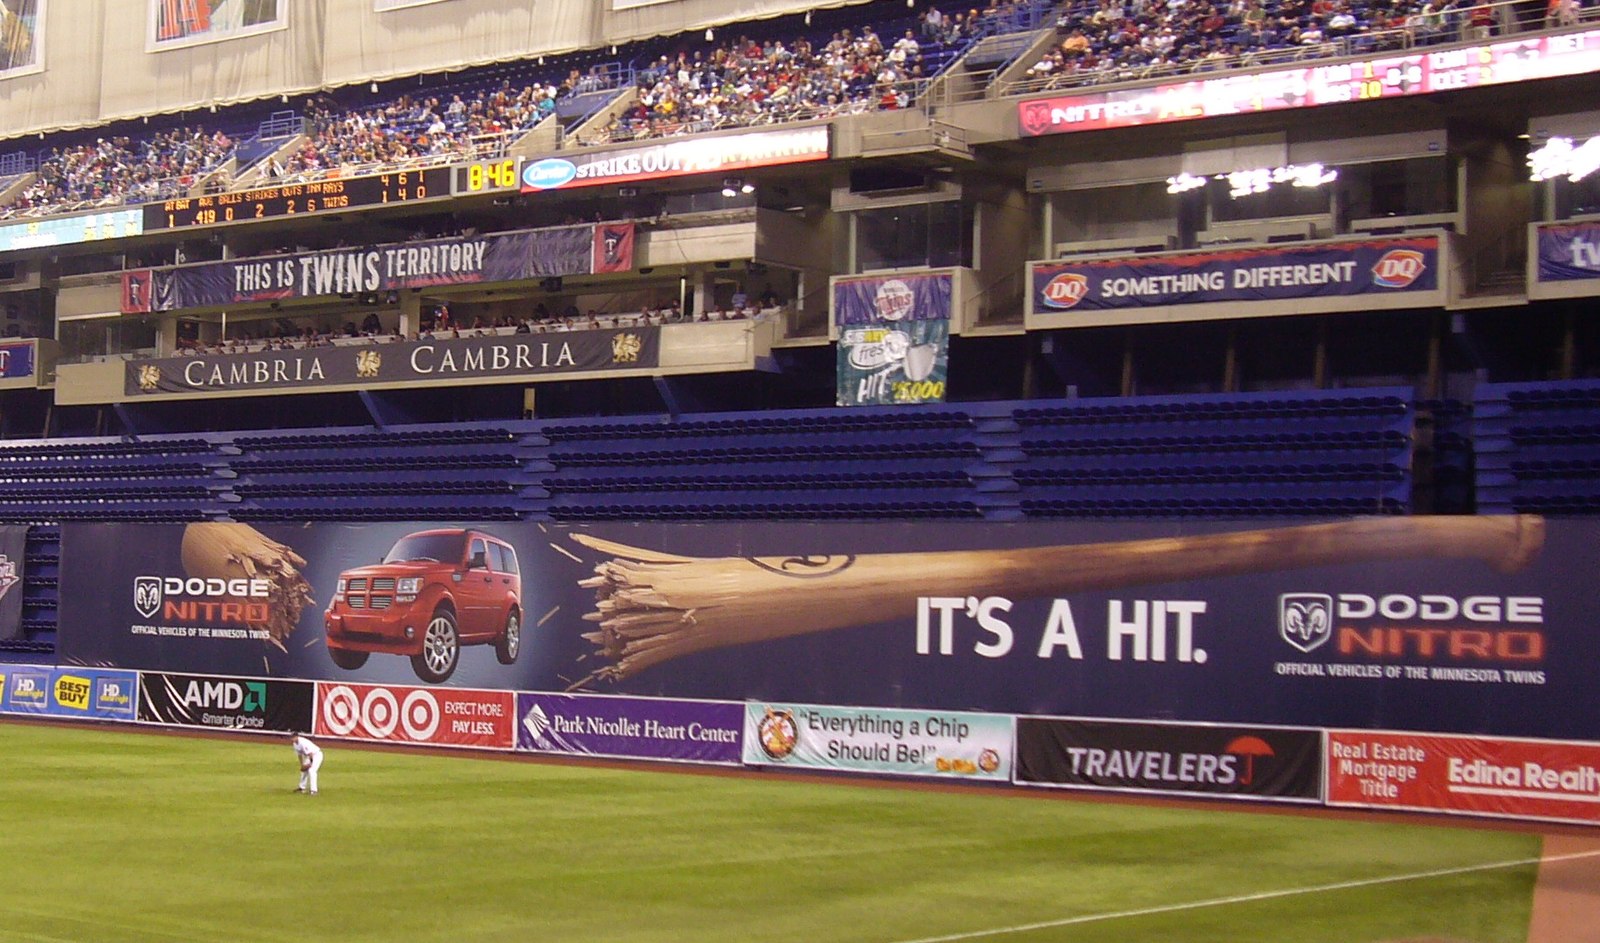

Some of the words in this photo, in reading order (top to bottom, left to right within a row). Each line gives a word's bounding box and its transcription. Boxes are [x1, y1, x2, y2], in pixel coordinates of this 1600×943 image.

[470, 160, 515, 190] 8:46
[576, 154, 641, 178] STRIKE
[165, 200, 174, 211] AT
[219, 193, 242, 205] BALLS
[245, 190, 279, 201] STRIKES
[282, 185, 302, 197] OUTS
[323, 181, 344, 194] RAYS
[381, 174, 389, 187] 4
[398, 172, 407, 185] 6
[226, 207, 233, 221] 0
[256, 204, 264, 218] 2
[287, 200, 295, 214] 2
[323, 194, 349, 208] TWINS
[398, 188, 407, 201] 4
[417, 186, 426, 199] 0
[234, 262, 271, 292] THIS
[276, 259, 294, 288] IS
[299, 250, 380, 297] TWINS
[385, 241, 487, 278] TERRITORY
[1100, 271, 1225, 298] SOMETHING
[1233, 260, 1358, 289] DIFFERENT
[1381, 258, 1417, 279] DQ
[1051, 281, 1080, 300] DQ
[410, 341, 577, 374] CAMBRIA
[184, 357, 326, 387] CAMBRIA
[164, 577, 270, 597] DODGE
[164, 600, 270, 622] NITRO
[1337, 592, 1545, 623] DODGE
[131, 625, 158, 635] OFFICIAL
[159, 626, 187, 637] VEHICLES
[188, 627, 197, 637] OF
[198, 627, 210, 638] THE
[211, 628, 248, 639] MINNESOTA
[249, 629, 270, 639] TWINS
[916, 595, 1015, 658] IT'S
[1036, 598, 1084, 660] A
[1107, 599, 1208, 664] HIT.
[1338, 626, 1544, 659] NITRO
[18, 678, 35, 691] HD
[1275, 662, 1325, 677] OFFICIAL
[1326, 663, 1382, 679] VEHICLES
[1385, 665, 1402, 679] OF
[1404, 666, 1428, 680] THE
[1430, 667, 1502, 683] MINNESOTA
[1504, 669, 1546, 685] TWINS
[59, 680, 89, 694] BEST
[59, 691, 85, 704] BUY
[103, 683, 120, 697] HD
[184, 680, 243, 709] AMD
[202, 712, 235, 726] Smarter
[236, 714, 265, 728] Choice
[444, 700, 477, 716] EXPECT
[452, 720, 470, 734] PAY
[554, 714, 586, 734] Park
[587, 716, 641, 738] Nicollet
[643, 719, 687, 740] Heart
[688, 722, 739, 743] Center
[909, 723, 920, 737] a
[925, 716, 969, 743] Chip
[827, 739, 891, 763] Should
[1332, 741, 1368, 759] Real
[1372, 743, 1425, 762] Estate
[1066, 746, 1237, 785] TRAVELERS
[1340, 758, 1417, 782] Mortgage
[1448, 757, 1521, 787] Edina
[1360, 779, 1398, 798] Title
